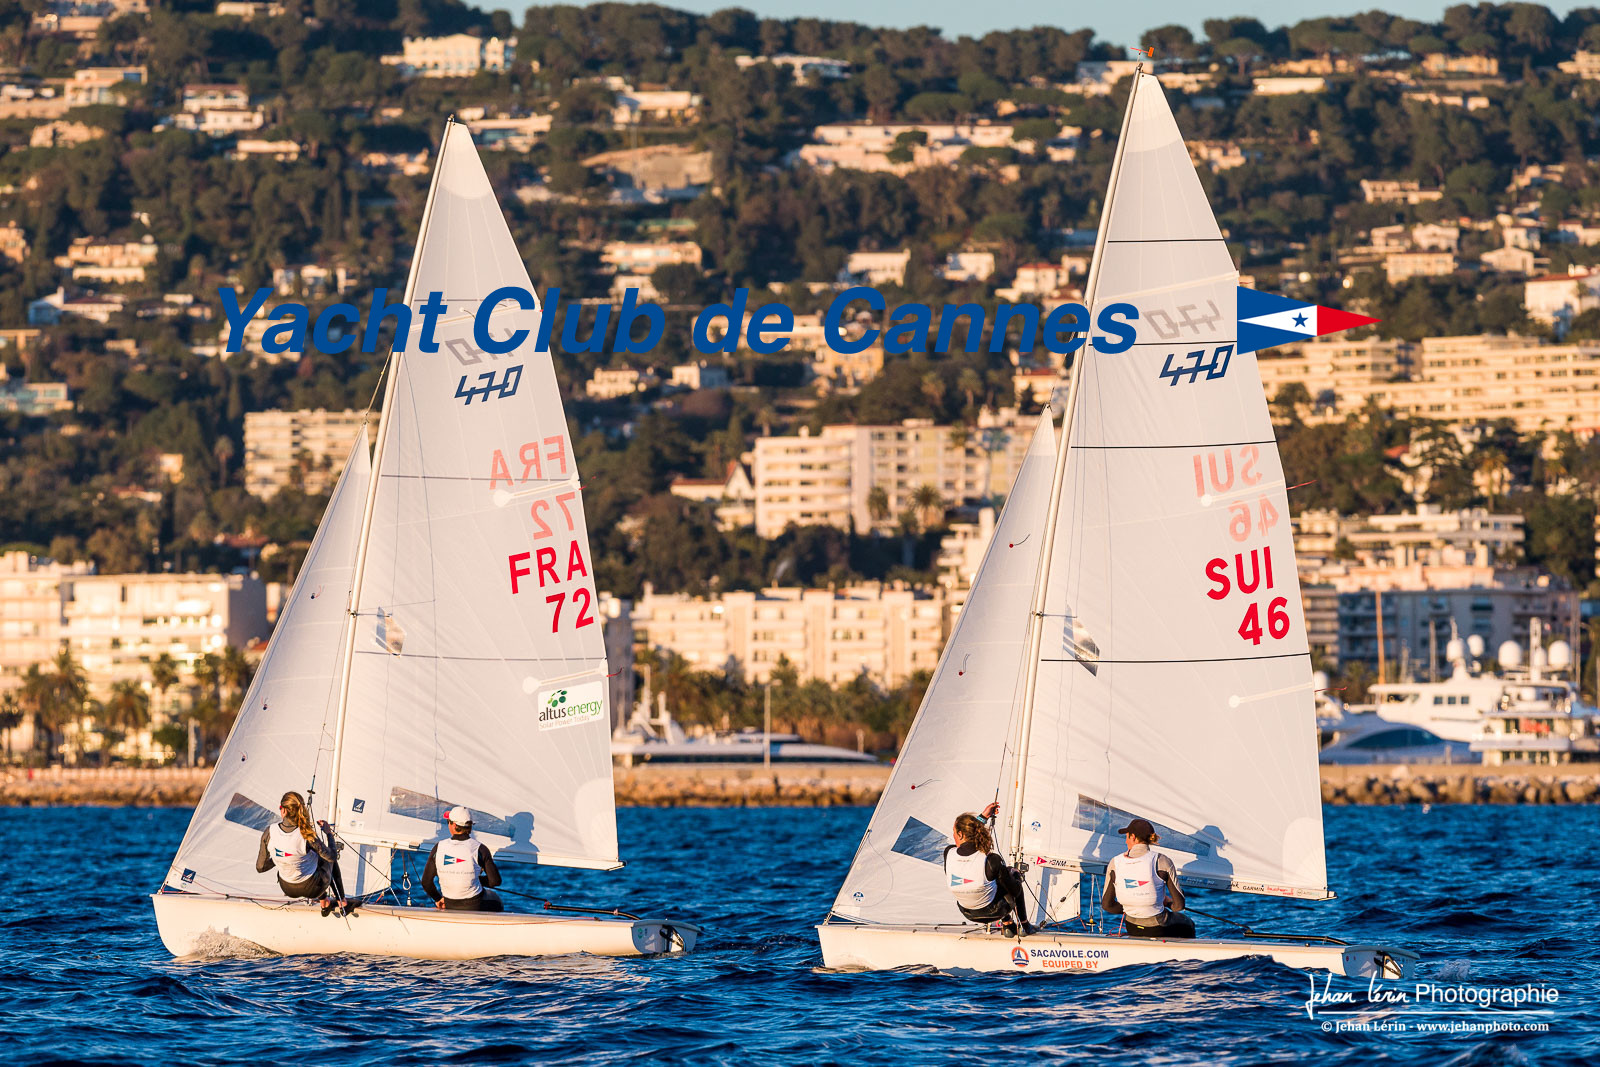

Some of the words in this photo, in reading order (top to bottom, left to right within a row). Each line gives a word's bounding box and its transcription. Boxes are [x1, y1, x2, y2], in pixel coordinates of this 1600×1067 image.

[454, 364, 524, 406] 470
[1158, 343, 1235, 387] 470
[508, 540, 588, 596] FRA
[1205, 545, 1275, 601] SUI
[545, 587, 594, 633] 72
[1237, 596, 1290, 646] 46
[1030, 949, 1109, 959] SACAVOILE.COM
[1042, 959, 1083, 969] EQUIPED
[1085, 960, 1099, 969] BY
